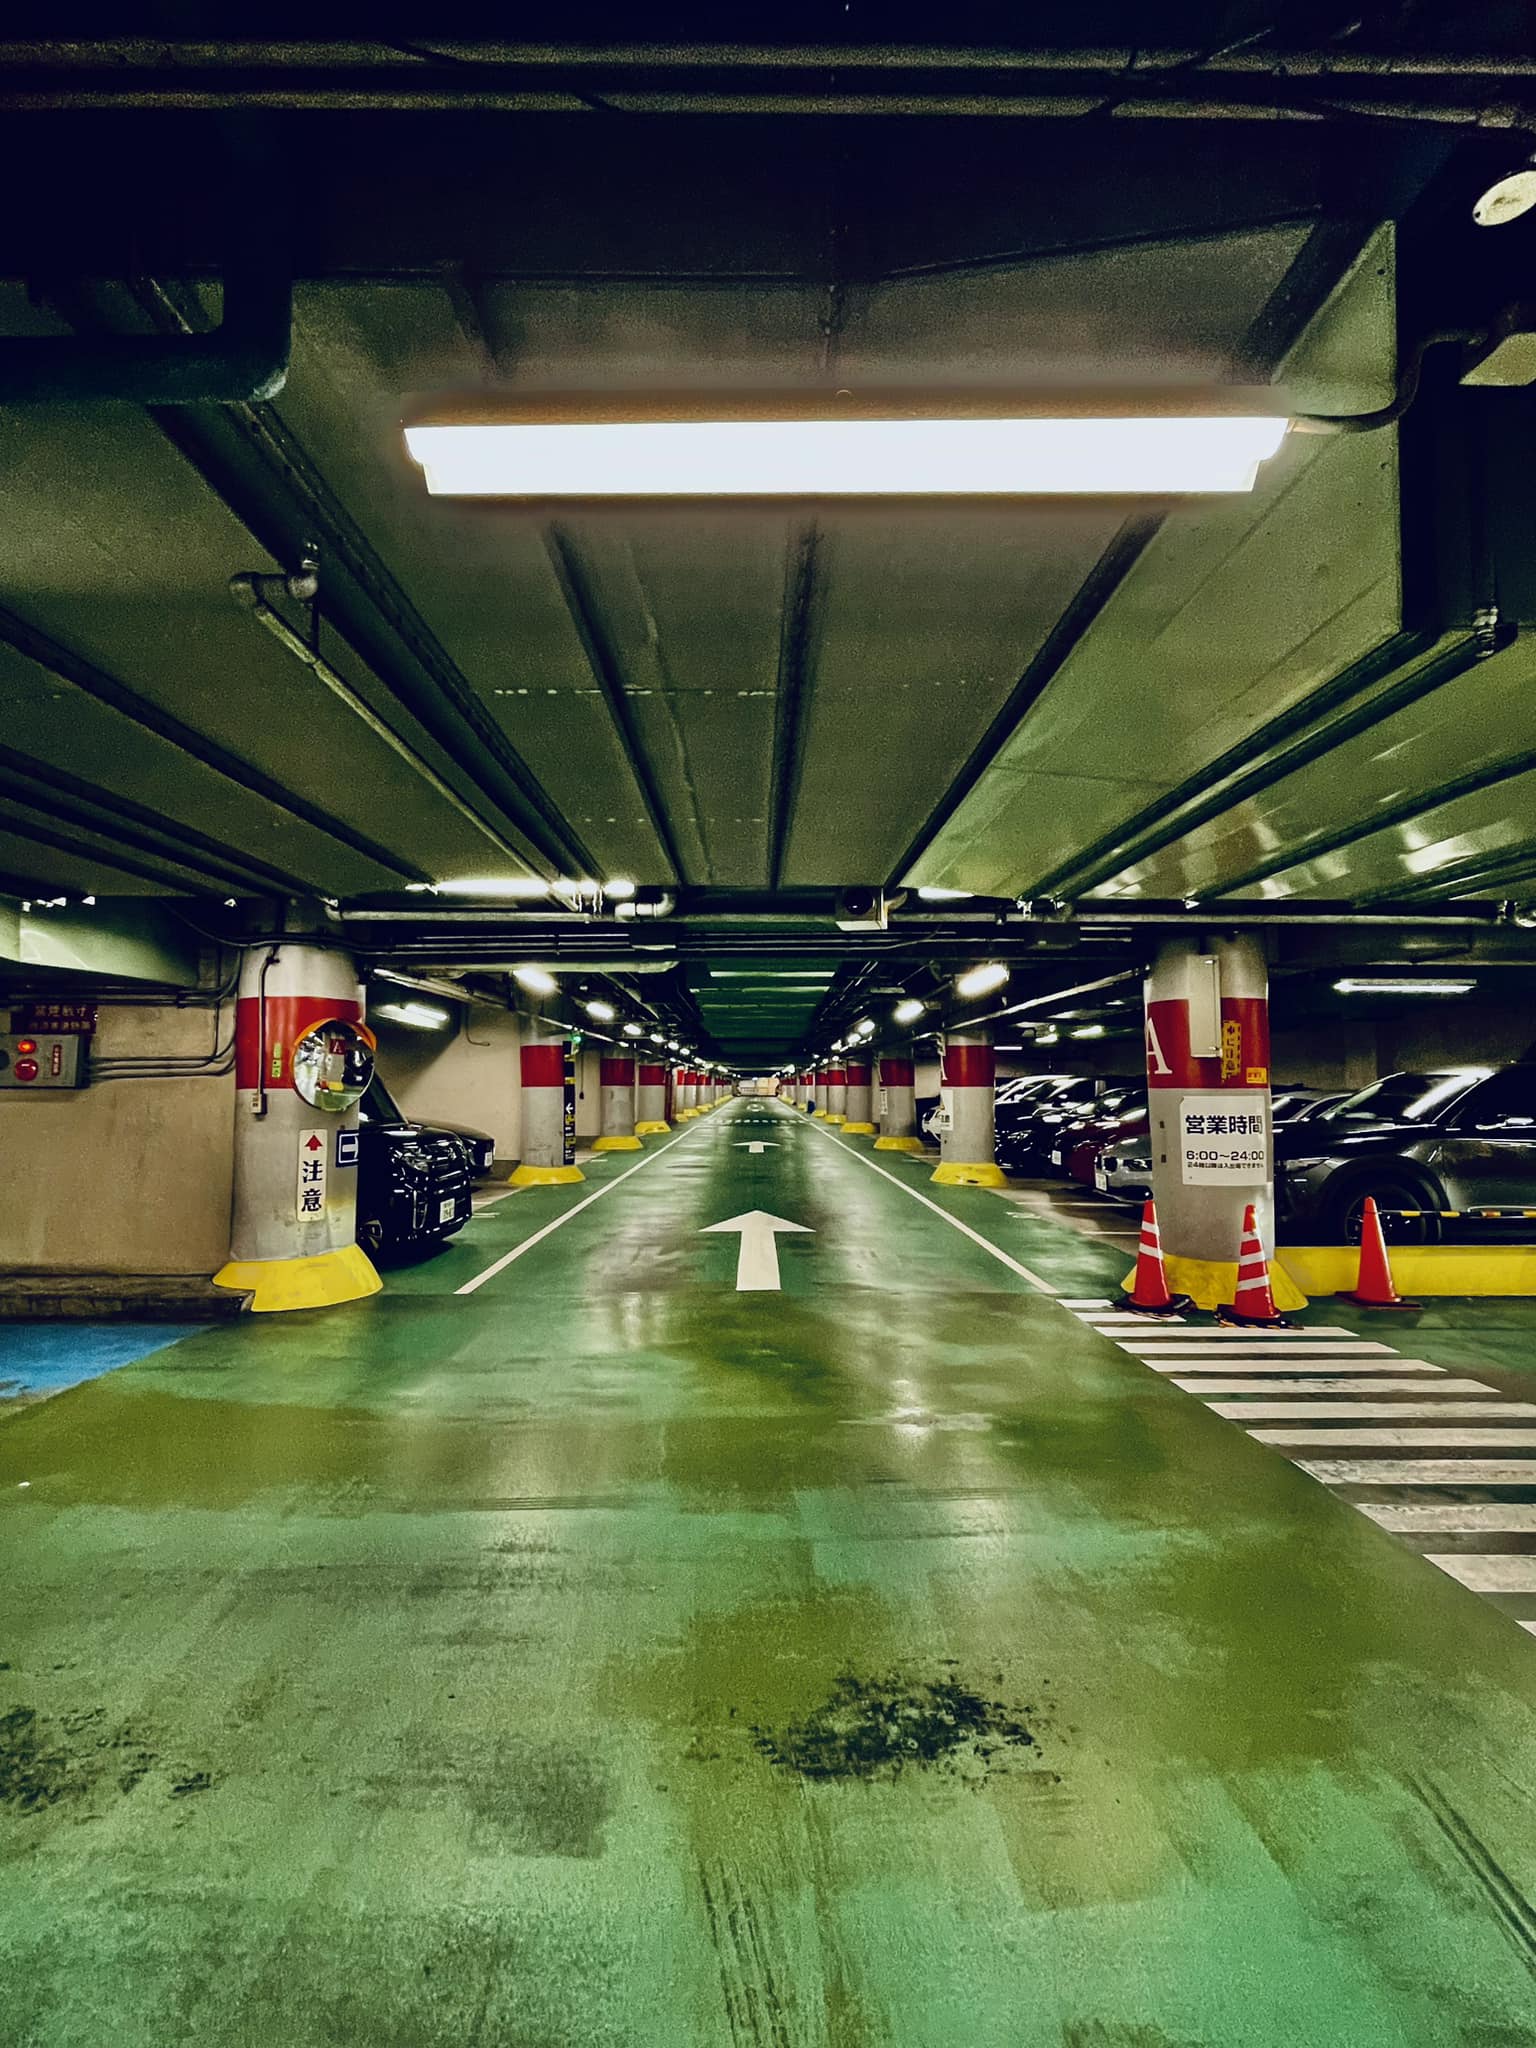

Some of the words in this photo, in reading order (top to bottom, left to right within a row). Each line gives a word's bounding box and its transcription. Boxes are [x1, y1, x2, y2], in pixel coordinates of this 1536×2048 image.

[1185, 1115, 1263, 1134] 営業時間
[302, 1160, 323, 1212] 注意
